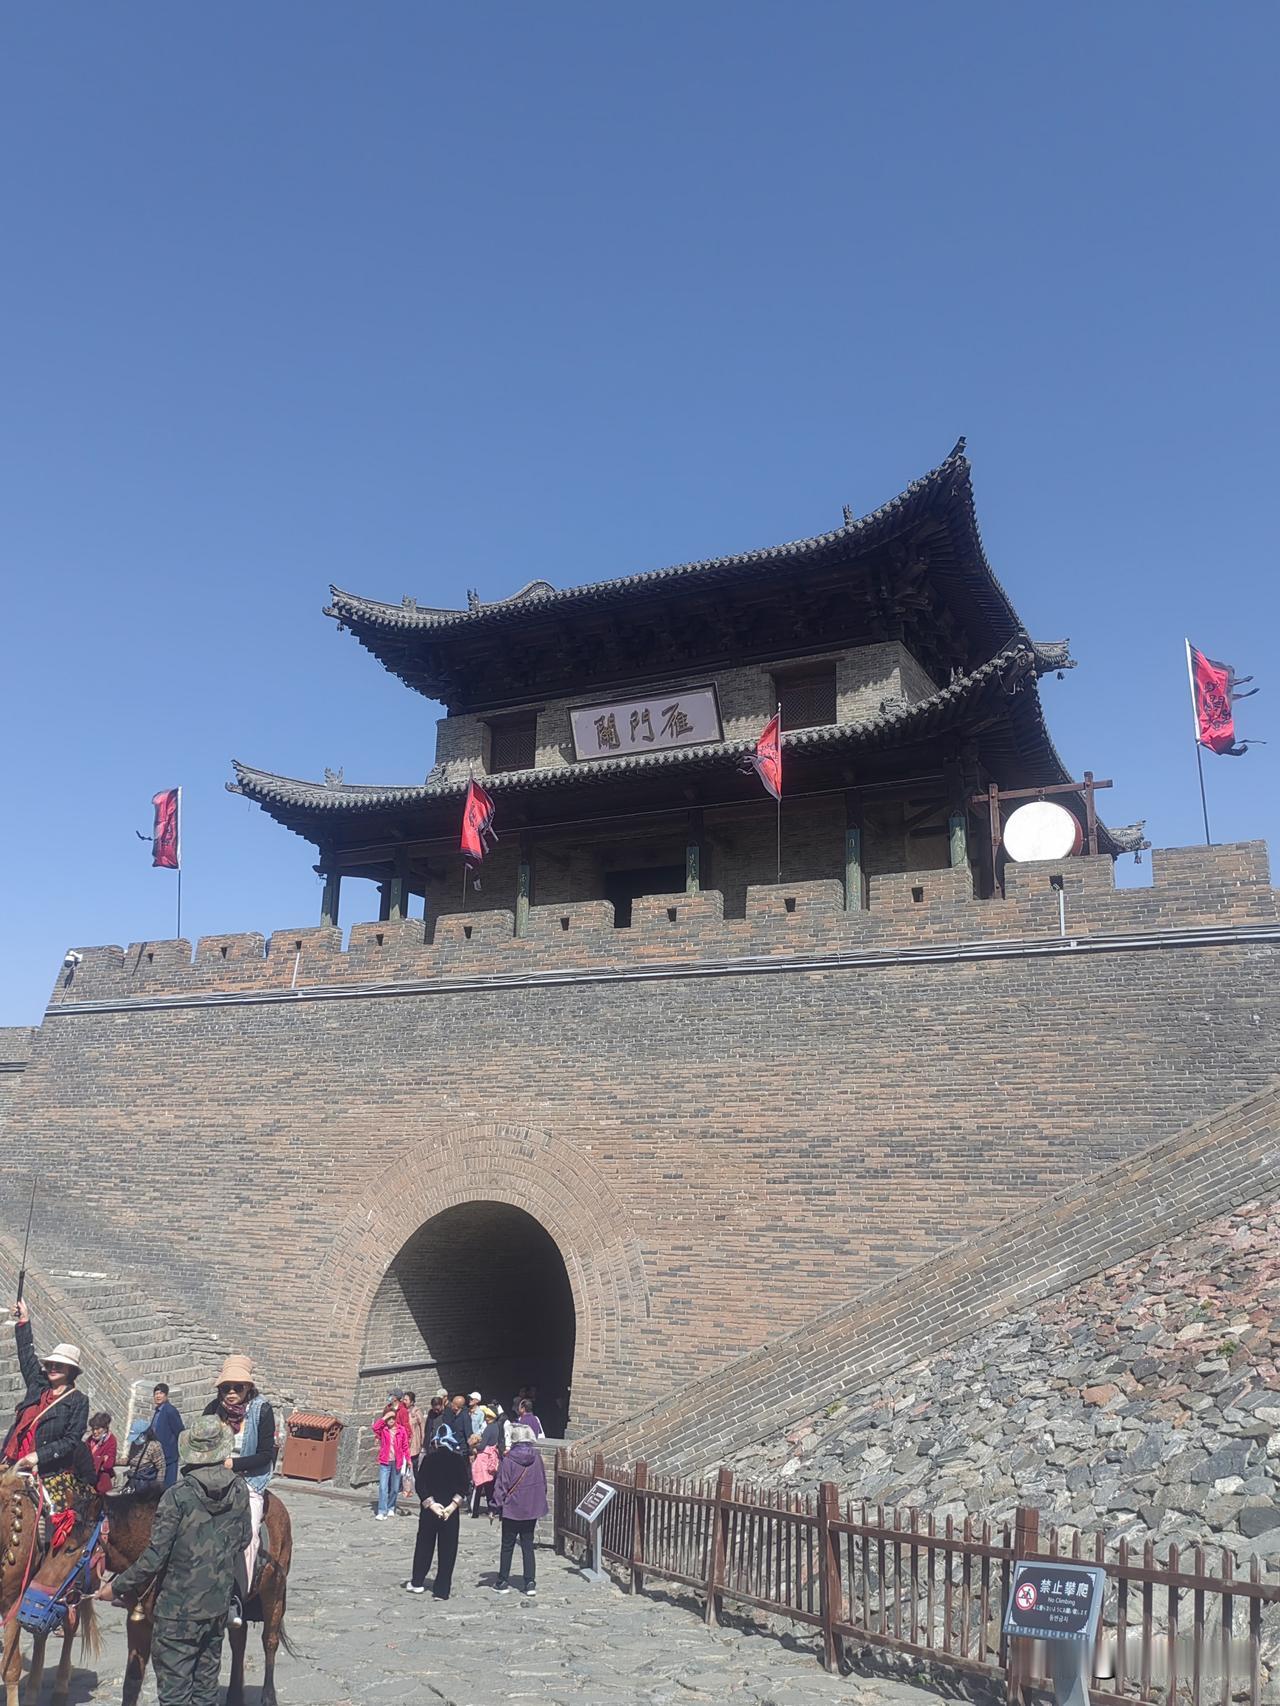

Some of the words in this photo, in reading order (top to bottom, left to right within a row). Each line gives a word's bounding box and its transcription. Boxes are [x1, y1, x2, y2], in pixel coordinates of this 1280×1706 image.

[1040, 1579, 1089, 1598] 禁止攀爬
[1056, 1598, 1076, 1606] Climbing
